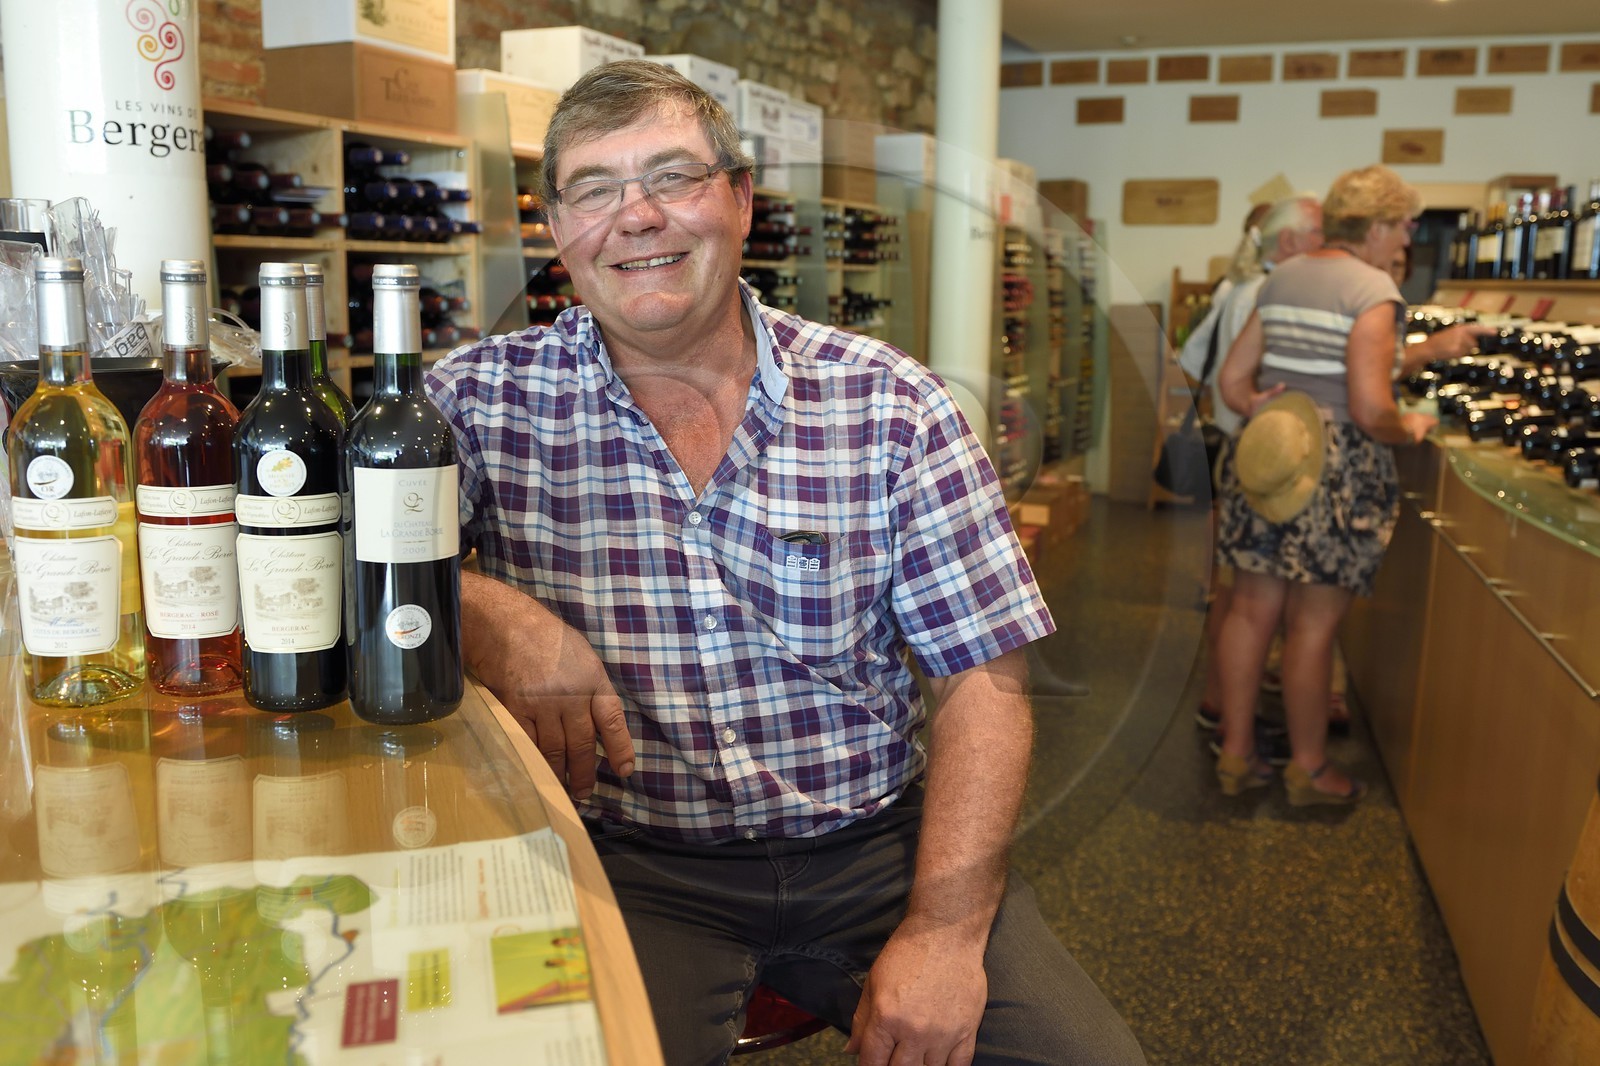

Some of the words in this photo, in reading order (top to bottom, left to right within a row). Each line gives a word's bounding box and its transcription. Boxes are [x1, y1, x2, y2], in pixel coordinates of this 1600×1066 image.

[115, 100, 142, 112] LES
[151, 103, 183, 116] VINS
[392, 528, 423, 538] GRANDE
[402, 545, 426, 554] 2009
[271, 624, 310, 632] BERGERAC
